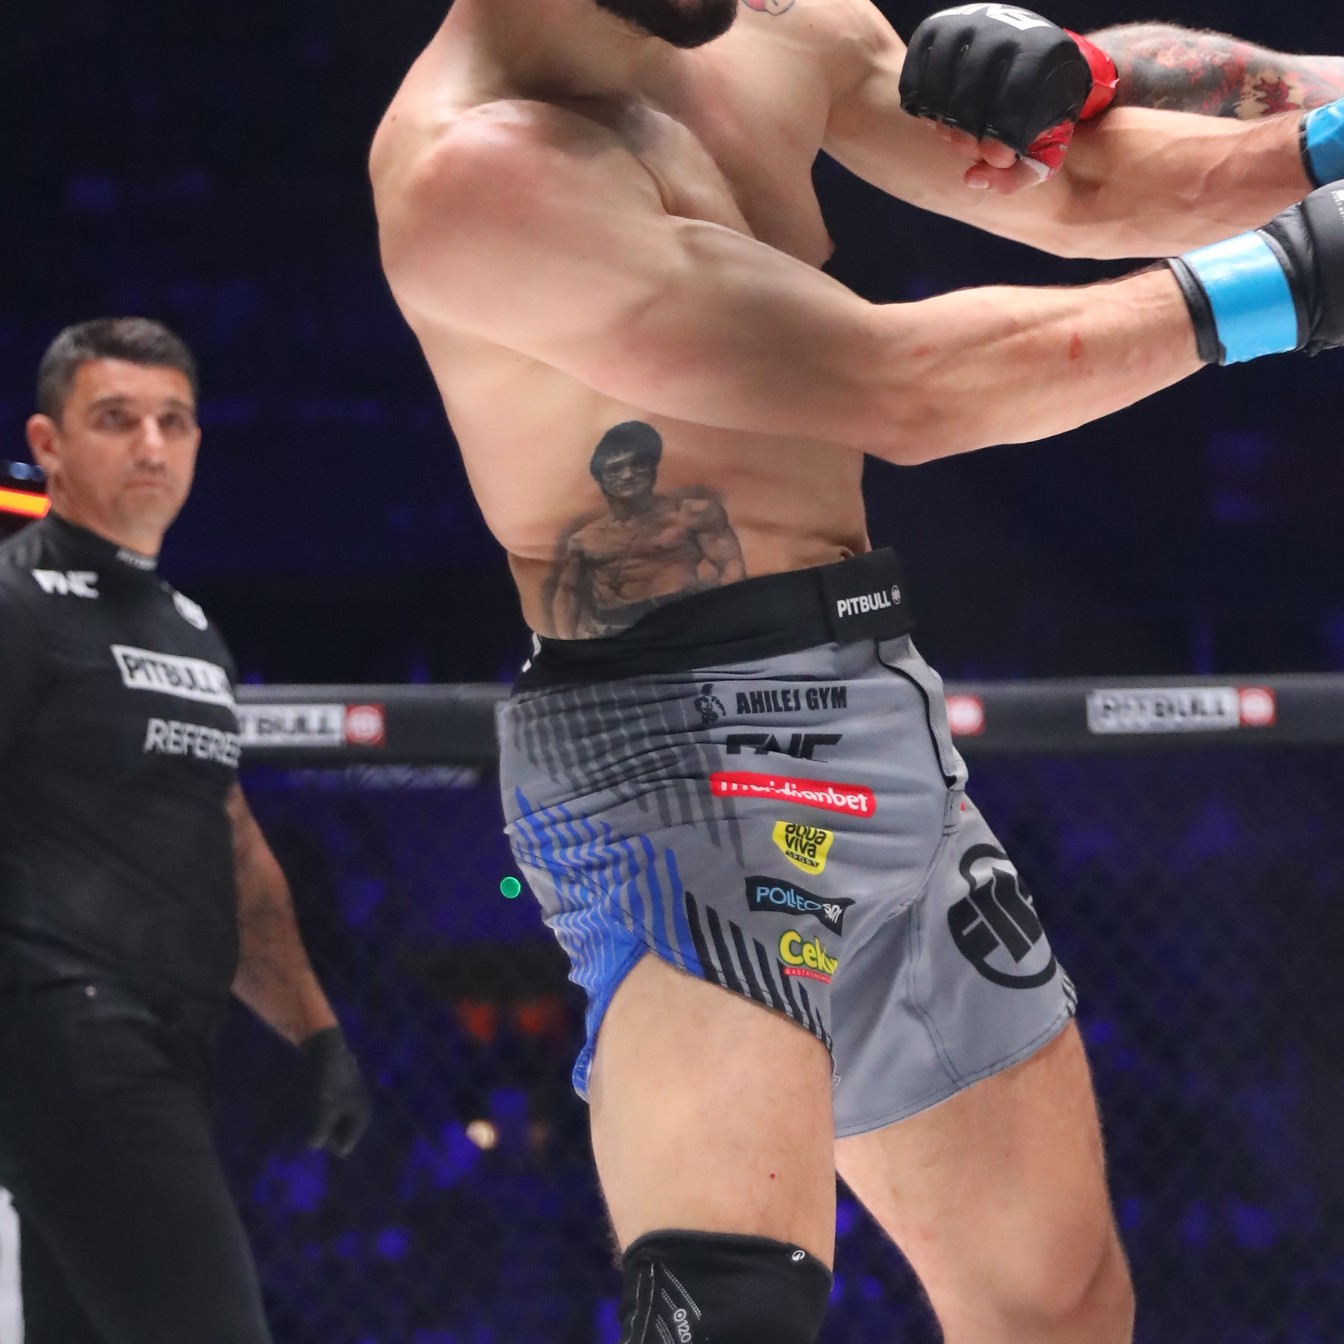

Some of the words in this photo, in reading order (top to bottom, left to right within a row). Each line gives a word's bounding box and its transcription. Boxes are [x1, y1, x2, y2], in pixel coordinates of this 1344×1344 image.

[836, 590, 892, 618] PITBULL
[122, 653, 218, 695] PITBULL
[736, 688, 801, 714] AHILEJ
[805, 686, 848, 712] GYM
[784, 834, 817, 859] viva
